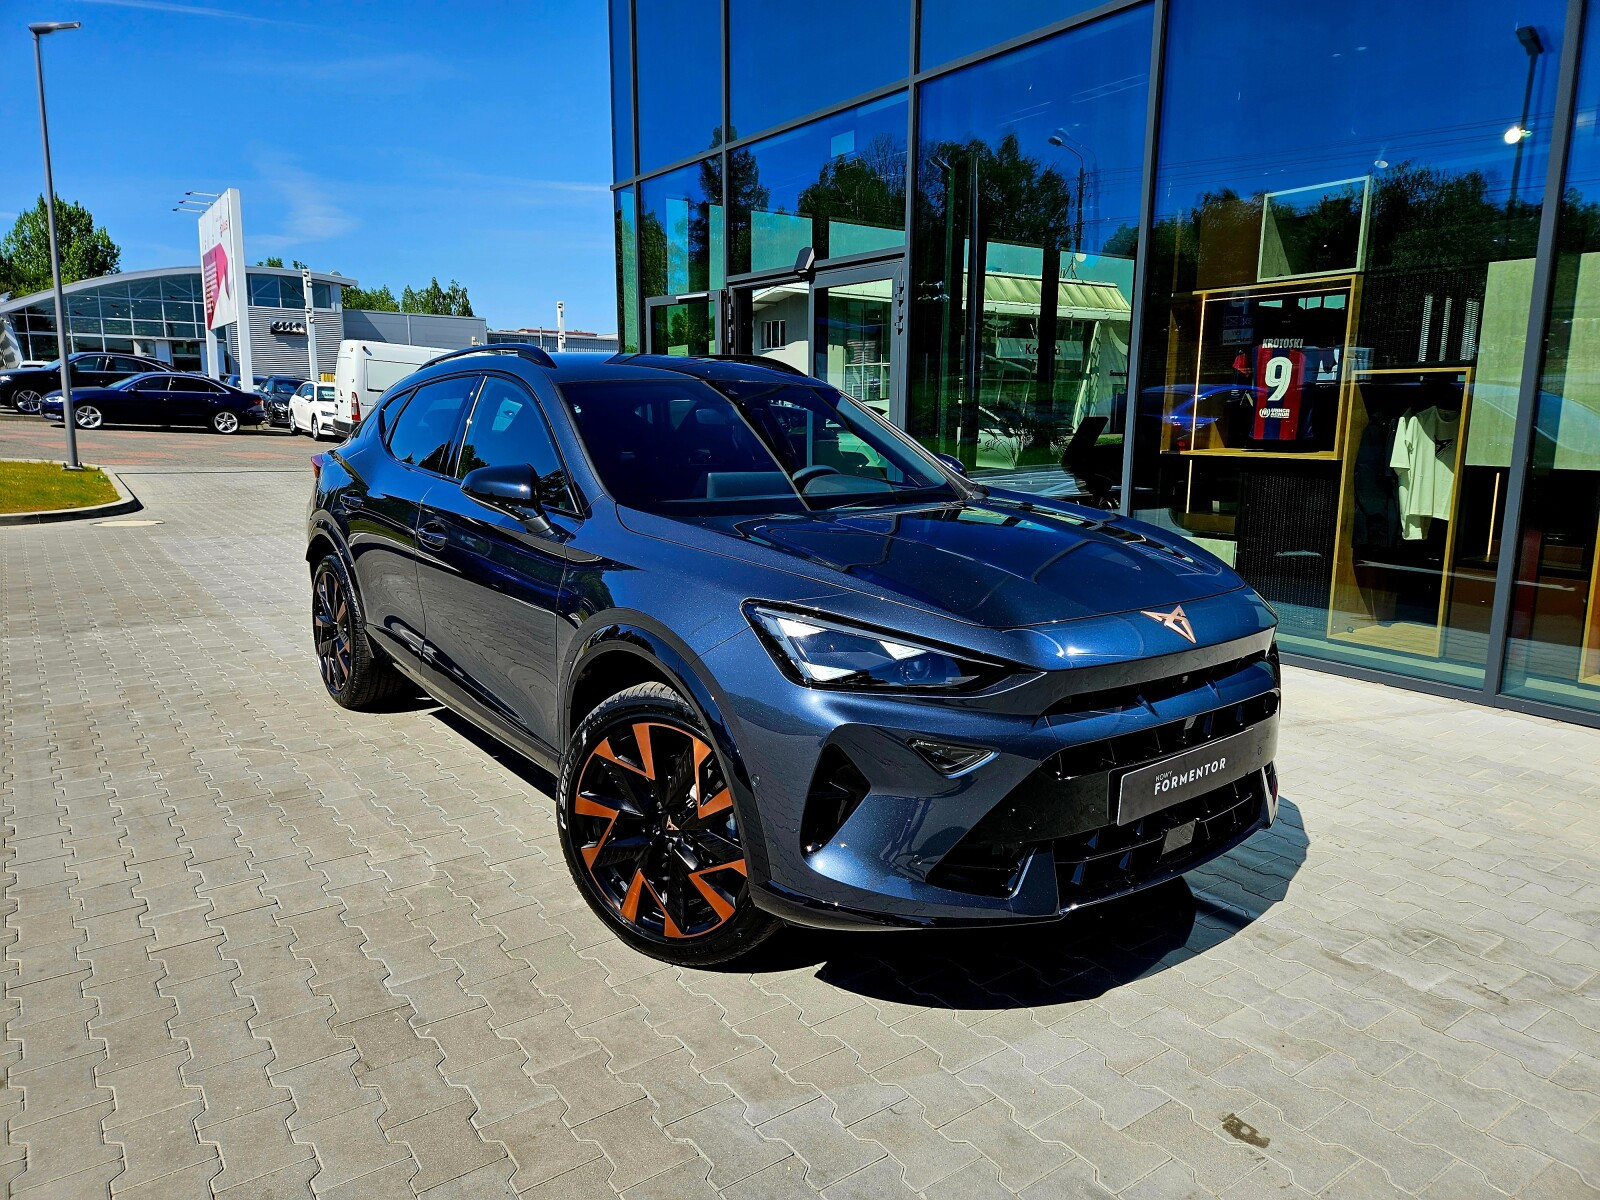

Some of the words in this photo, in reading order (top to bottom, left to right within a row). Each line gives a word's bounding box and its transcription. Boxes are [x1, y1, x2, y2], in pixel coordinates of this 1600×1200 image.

[1262, 338, 1304, 349] KROTOSKI
[1265, 356, 1293, 401] 9
[1154, 758, 1226, 795] FORMENTOR
[1155, 770, 1173, 782] NOWY
